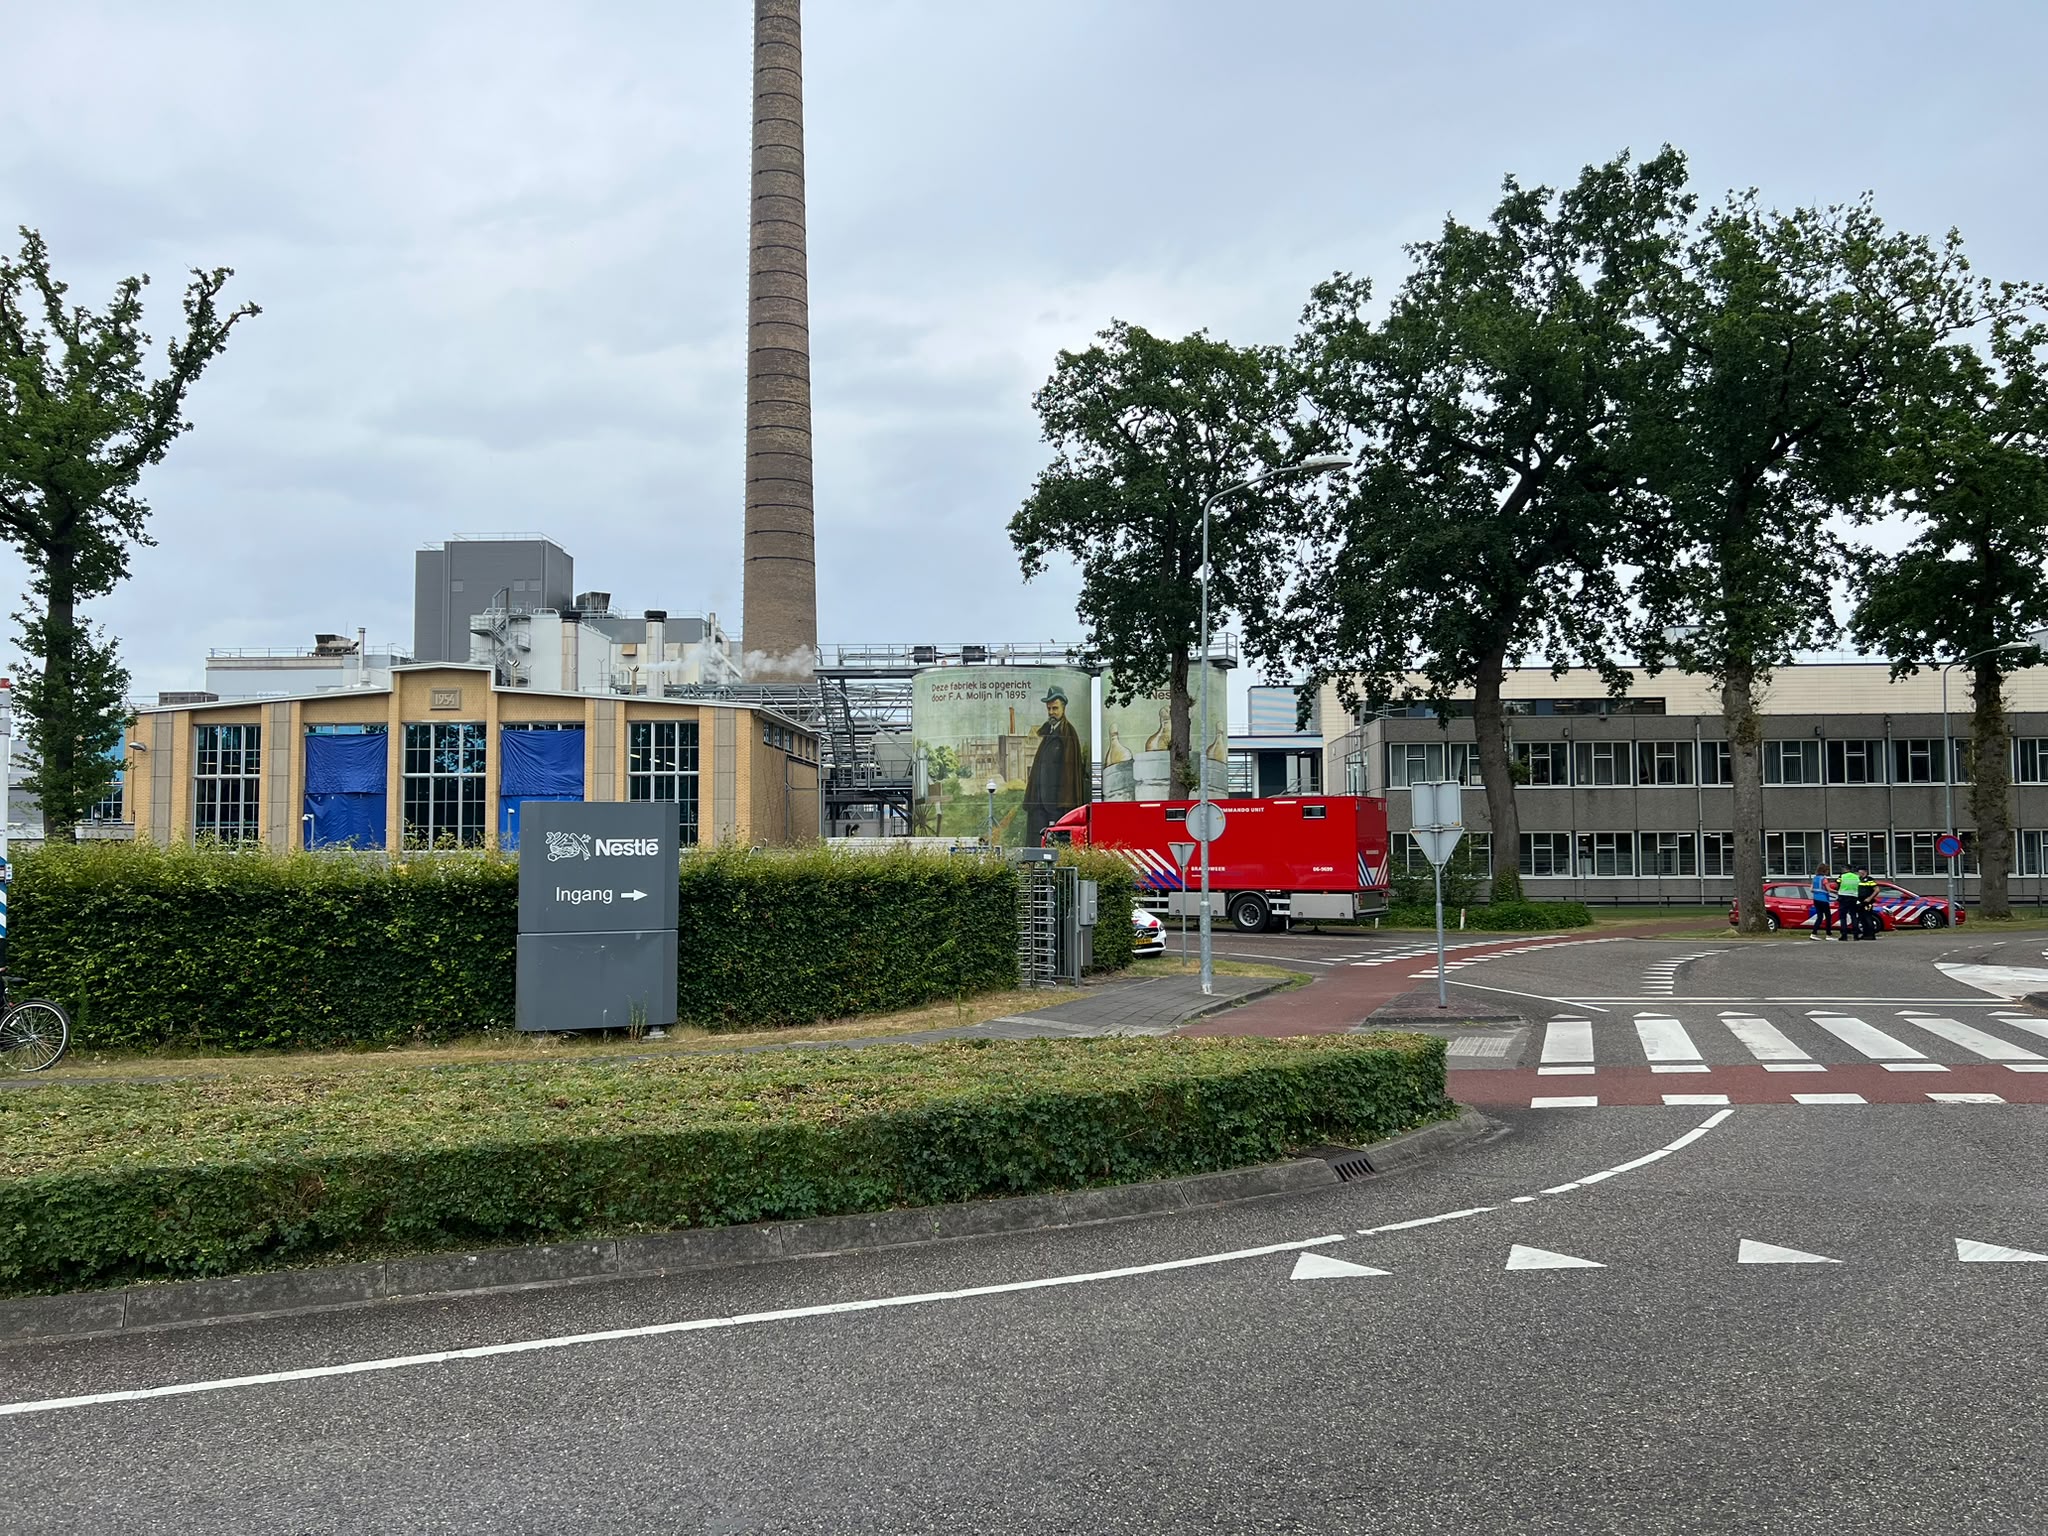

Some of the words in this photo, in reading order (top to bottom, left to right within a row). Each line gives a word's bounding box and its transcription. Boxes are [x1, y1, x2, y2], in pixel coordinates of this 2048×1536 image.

[932, 684, 949, 692] Deze
[950, 681, 978, 691] fabriek
[980, 681, 987, 690] is
[988, 680, 1032, 691] opgericht
[435, 693, 455, 705] 1954
[932, 693, 947, 702] door
[995, 691, 1003, 700] in
[1005, 690, 1027, 700] 1895
[595, 838, 659, 857] Nestlé
[555, 886, 613, 905] Ingang
